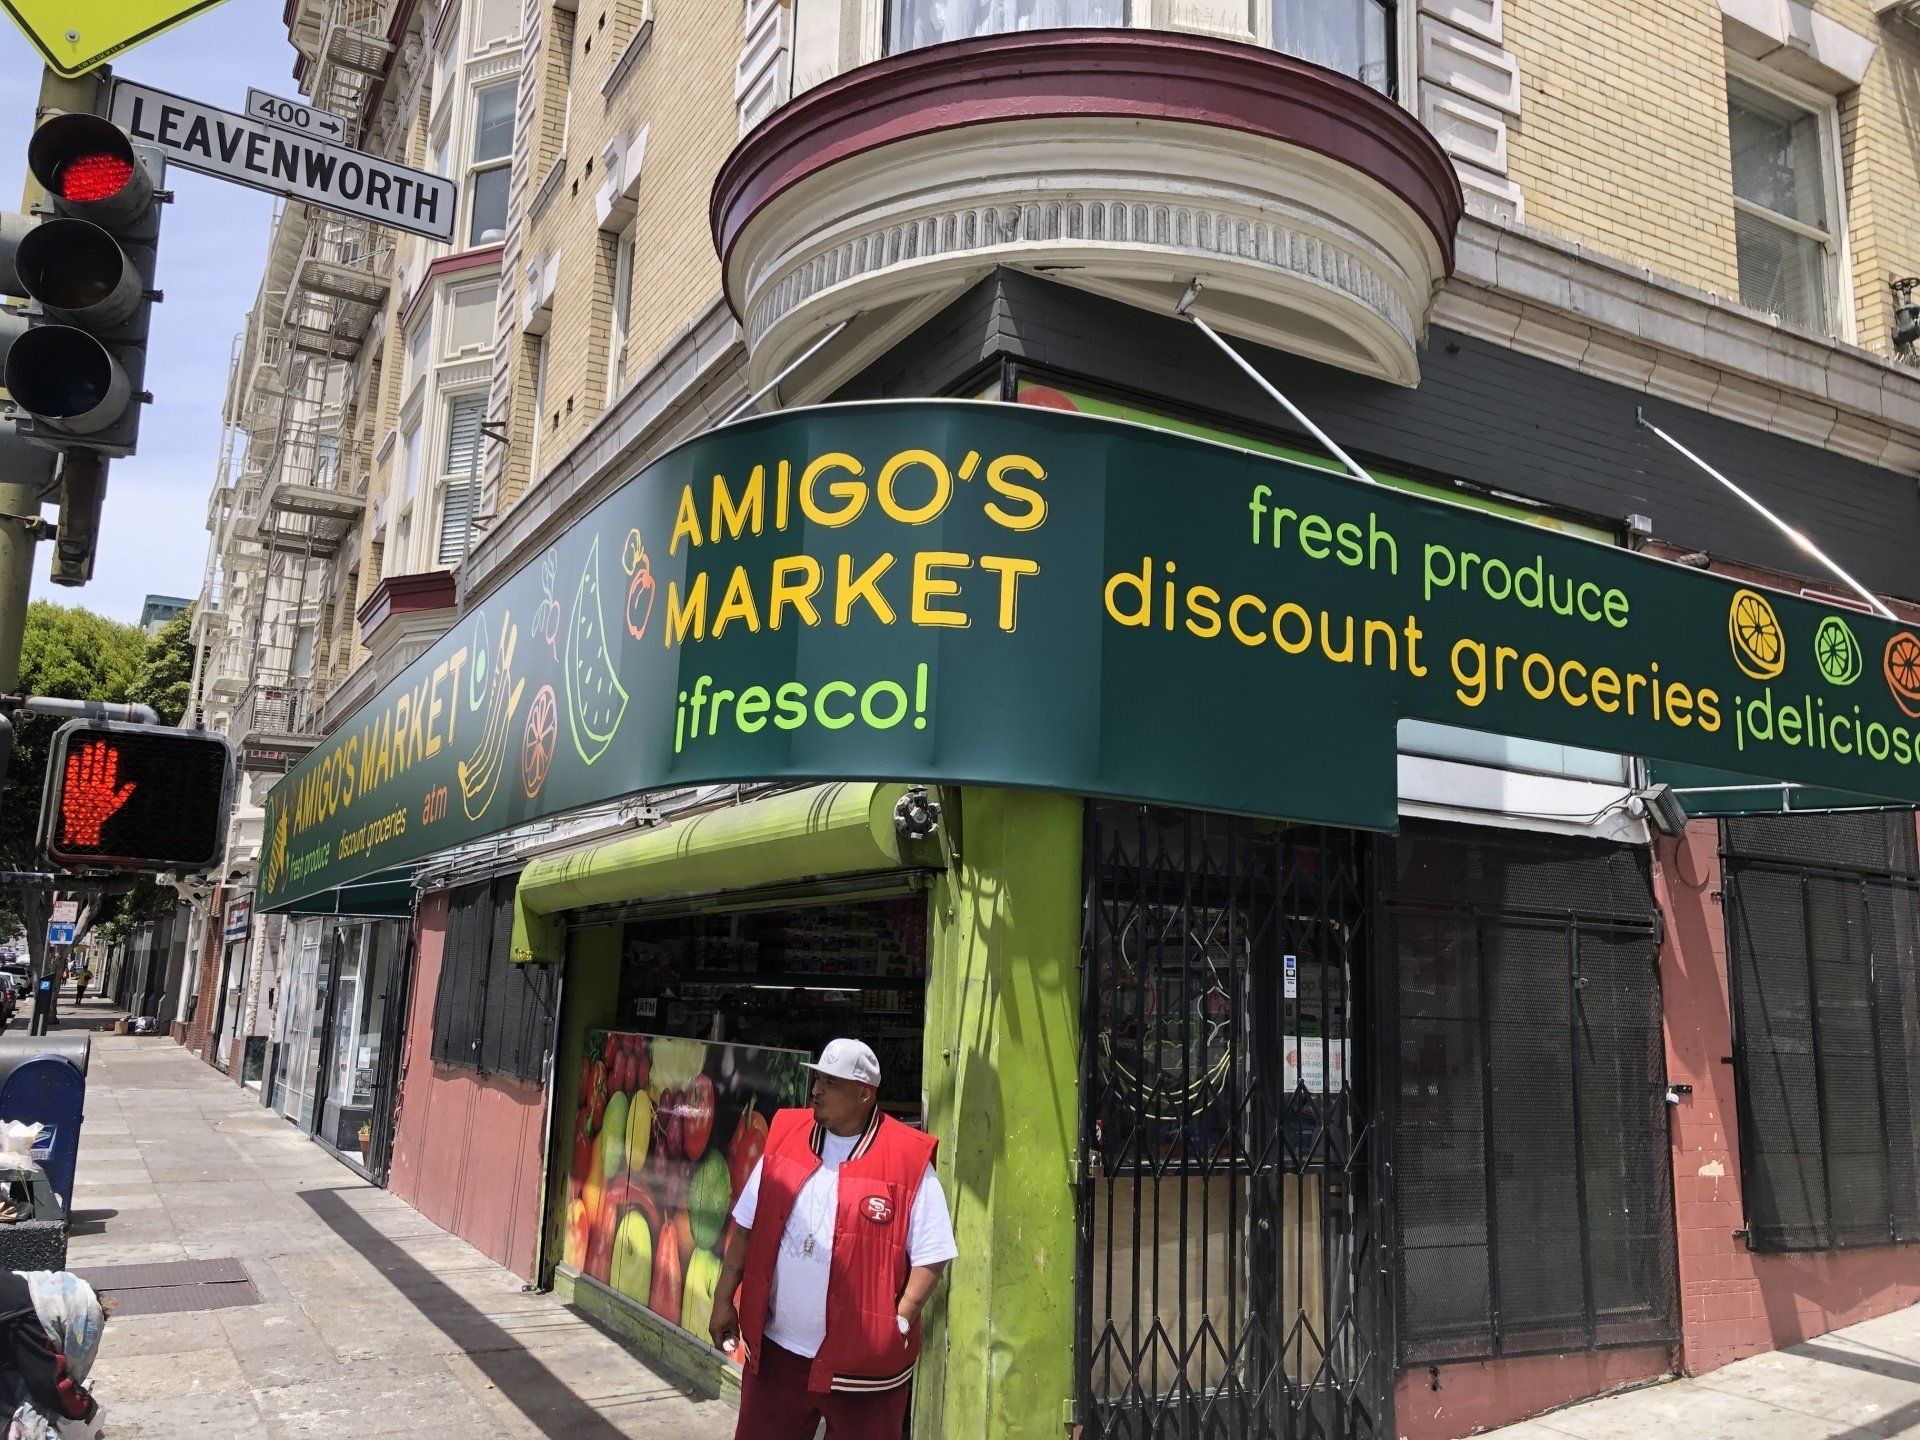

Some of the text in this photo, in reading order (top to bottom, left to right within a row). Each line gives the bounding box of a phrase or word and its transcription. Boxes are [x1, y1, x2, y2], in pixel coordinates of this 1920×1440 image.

[259, 98, 311, 128] 400
[130, 97, 439, 224] LEAVENWORTH
[669, 449, 1049, 557] AMIGO'S
[664, 551, 1041, 649] MARKET
[1248, 484, 1630, 628] fresh produce
[1104, 556, 1722, 733] discount groceries
[293, 646, 468, 836] AMIGO'S MARKET
[1734, 687, 1920, 765] ¡delicios
[338, 803, 408, 861] discount groceries
[421, 783, 448, 826] atm
[289, 840, 331, 885] fresh produce
[639, 1000, 656, 1013] ATM
